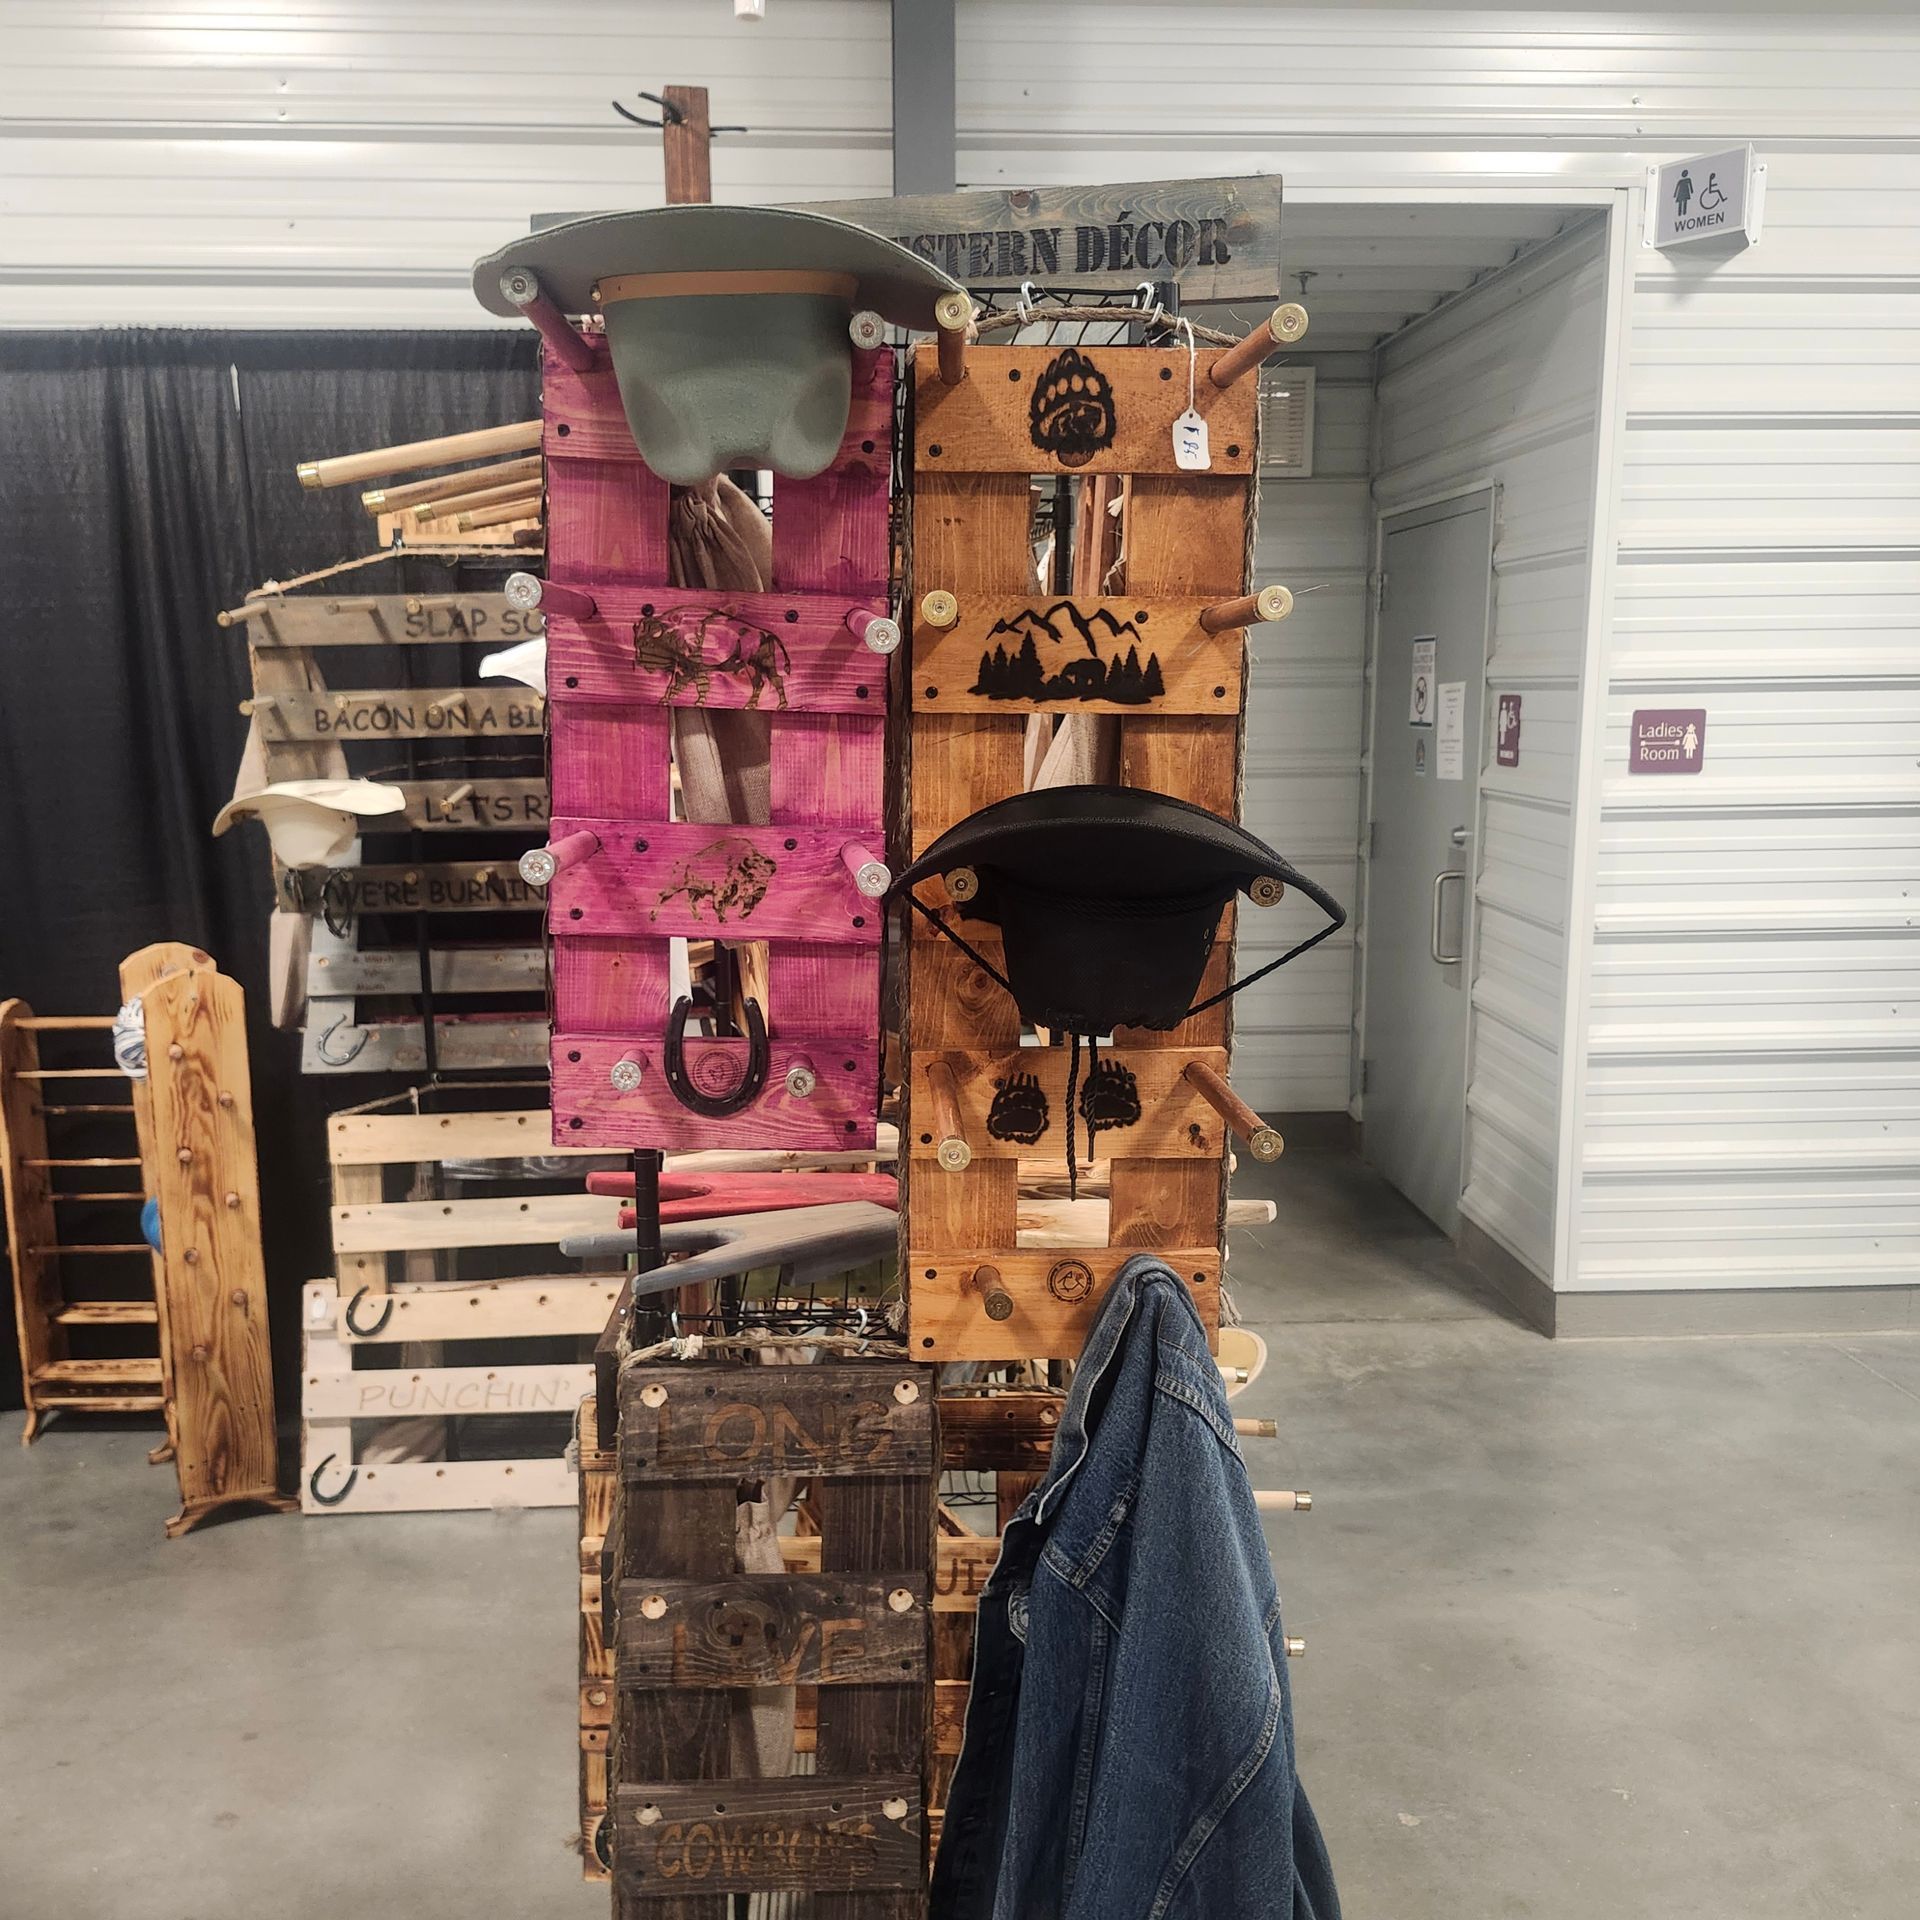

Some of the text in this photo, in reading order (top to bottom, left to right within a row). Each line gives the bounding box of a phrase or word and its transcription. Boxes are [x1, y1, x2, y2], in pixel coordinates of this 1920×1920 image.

[1674, 212, 1725, 233] WOMEN
[1075, 210, 1231, 272] DÉCOR
[406, 608, 487, 637] SLAP
[315, 706, 416, 732] BACON
[425, 705, 469, 730] ON
[479, 706, 497, 729] A
[1639, 722, 1684, 738] Ladies
[1640, 748, 1679, 761] Room
[425, 794, 548, 823] LET'S R
[331, 879, 420, 906] WE'RE
[359, 1380, 571, 1411] PUNCHIN'
[657, 1401, 894, 1466] LONG
[673, 1618, 868, 1685] LVE
